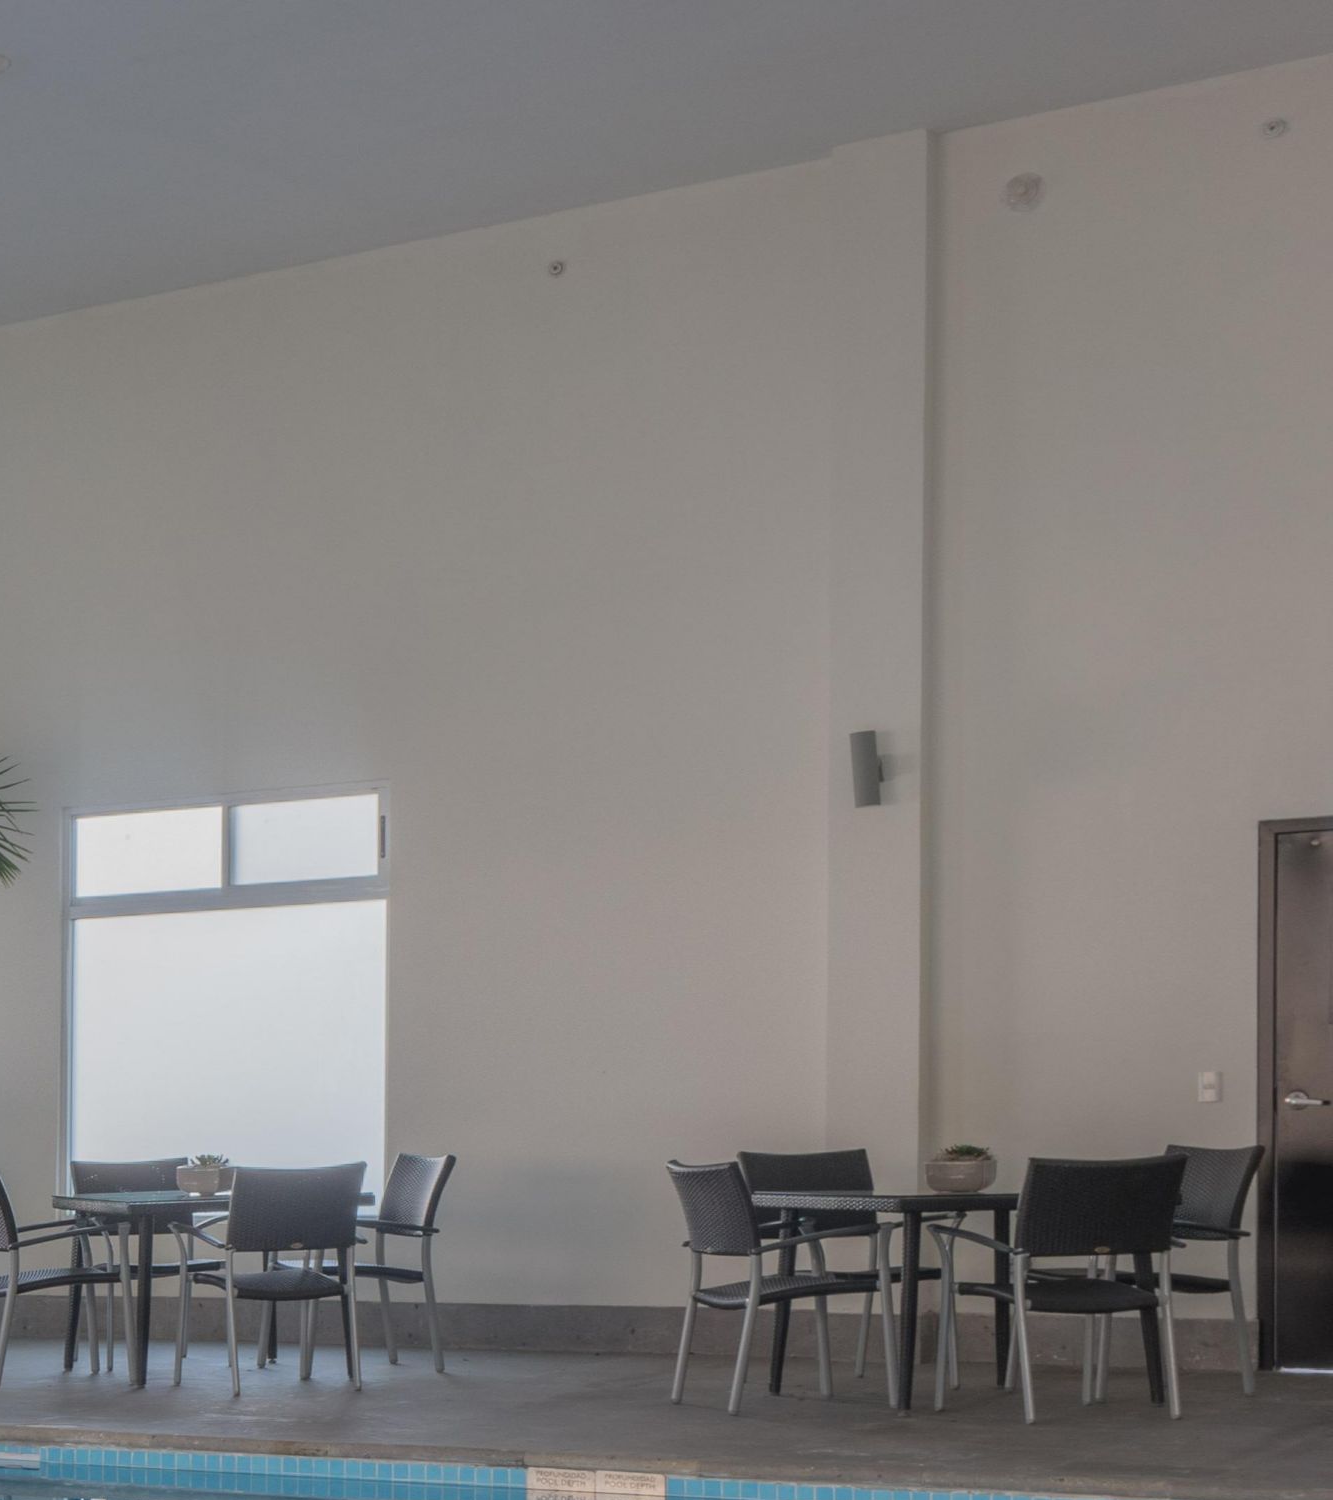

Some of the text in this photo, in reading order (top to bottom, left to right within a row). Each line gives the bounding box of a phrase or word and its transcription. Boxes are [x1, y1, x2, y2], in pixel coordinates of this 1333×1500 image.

[536, 1478, 587, 1488] POOL DEPTH
[604, 1480, 657, 1490] POOL DEPTH
